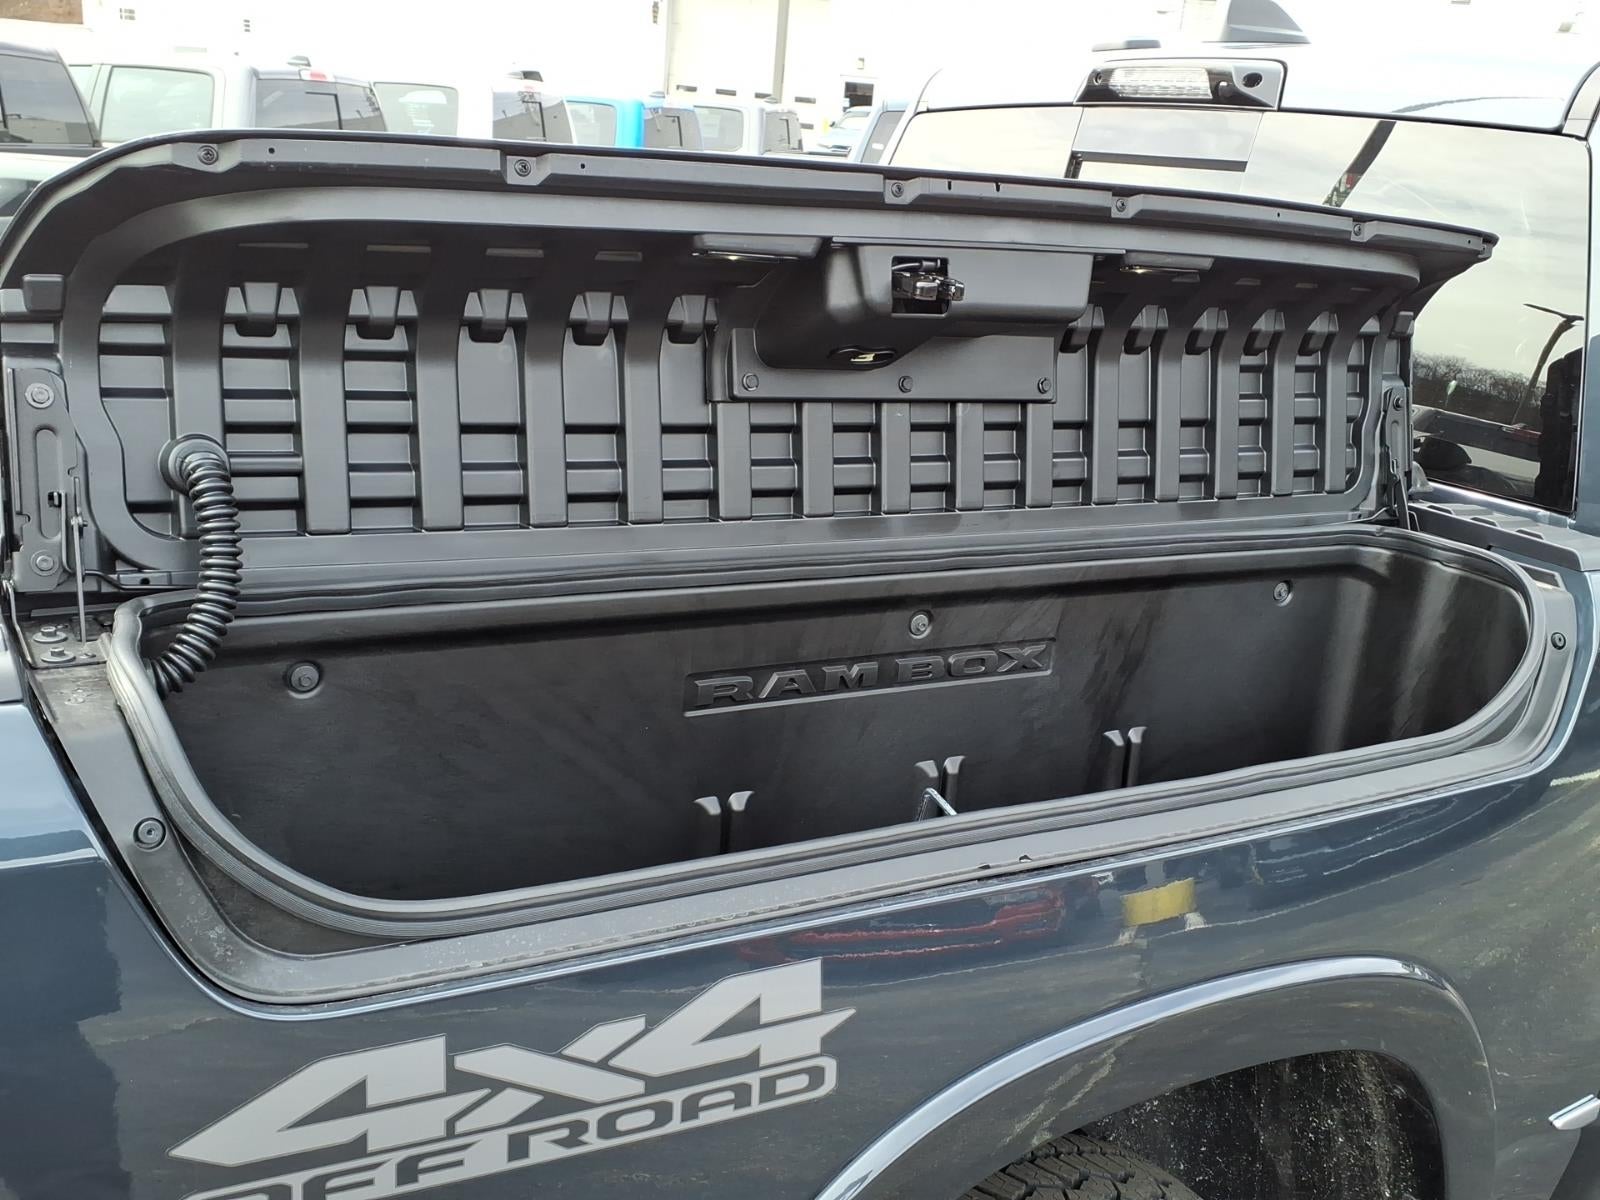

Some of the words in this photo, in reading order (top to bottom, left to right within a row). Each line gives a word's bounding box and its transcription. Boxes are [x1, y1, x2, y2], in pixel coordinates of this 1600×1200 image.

[694, 661, 880, 706] RAM
[895, 643, 1047, 684] BOX
[507, 1063, 826, 1163] ROAD
